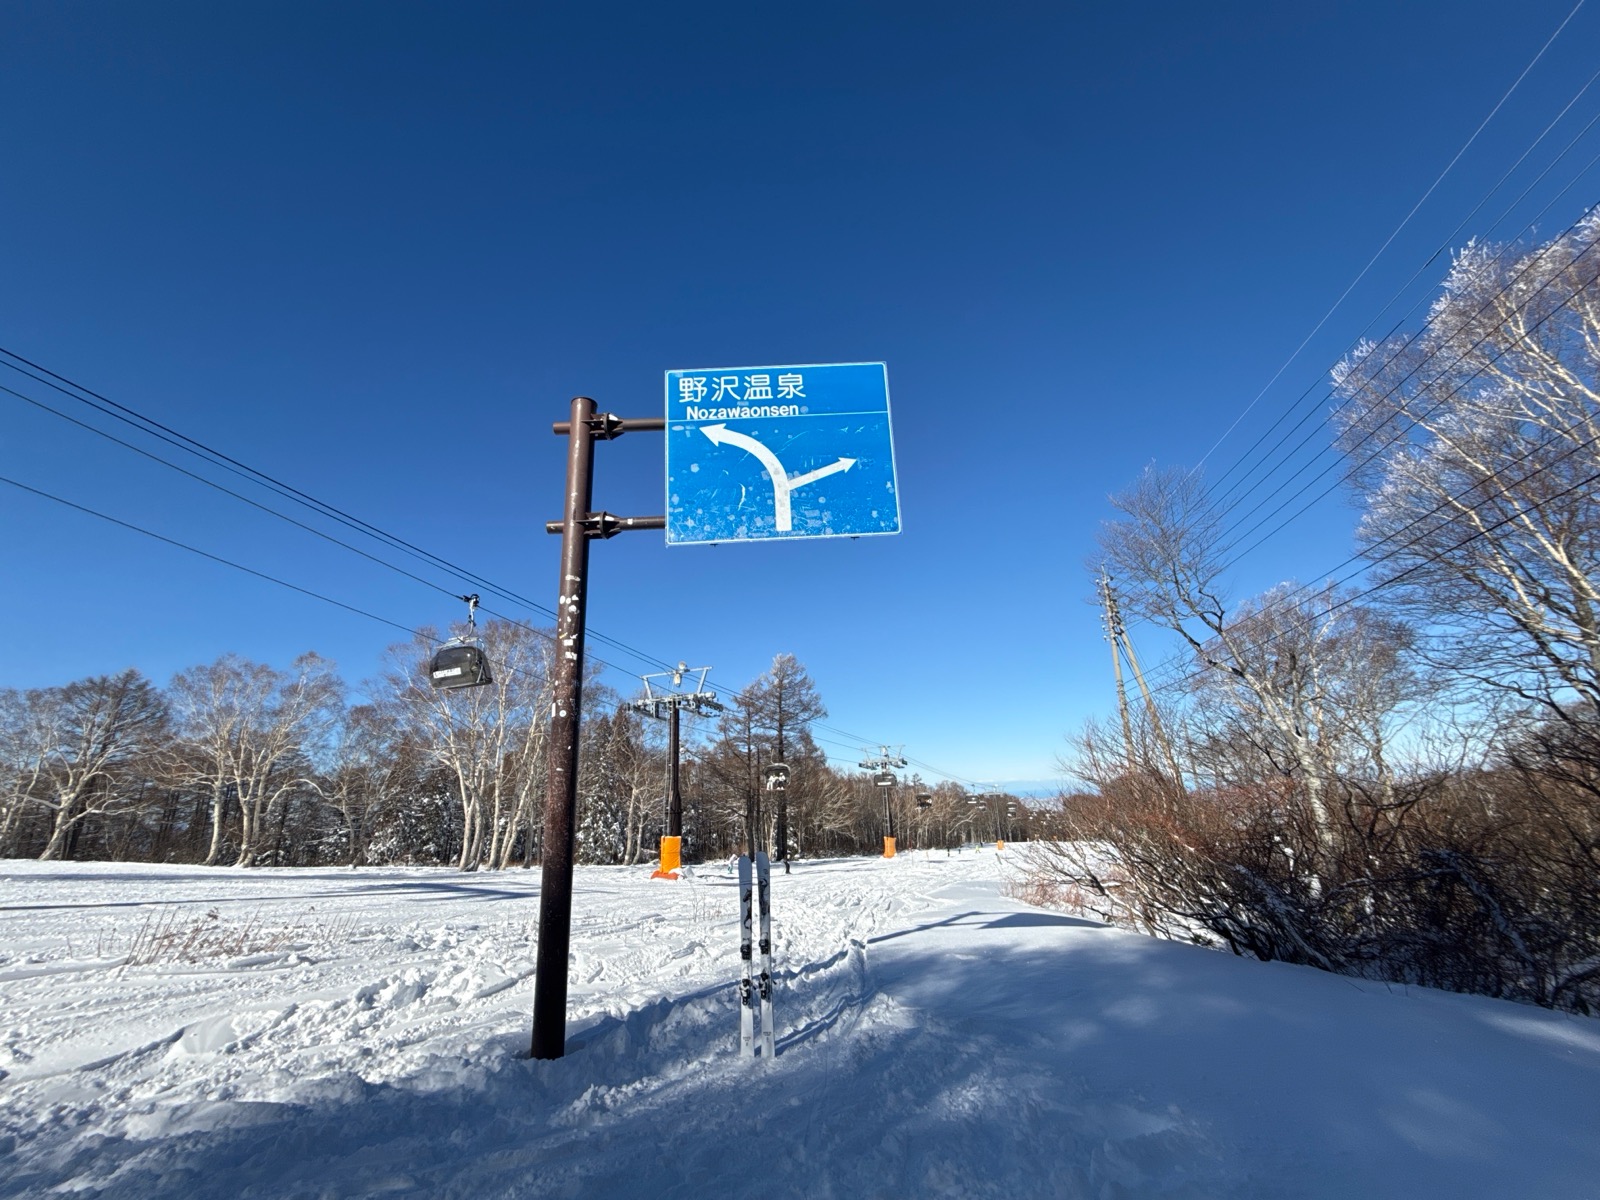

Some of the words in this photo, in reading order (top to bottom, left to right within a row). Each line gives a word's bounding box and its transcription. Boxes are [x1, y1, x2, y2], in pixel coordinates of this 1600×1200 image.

[678, 373, 807, 403] 野沢温泉
[686, 404, 799, 420] Nozawaonsen
